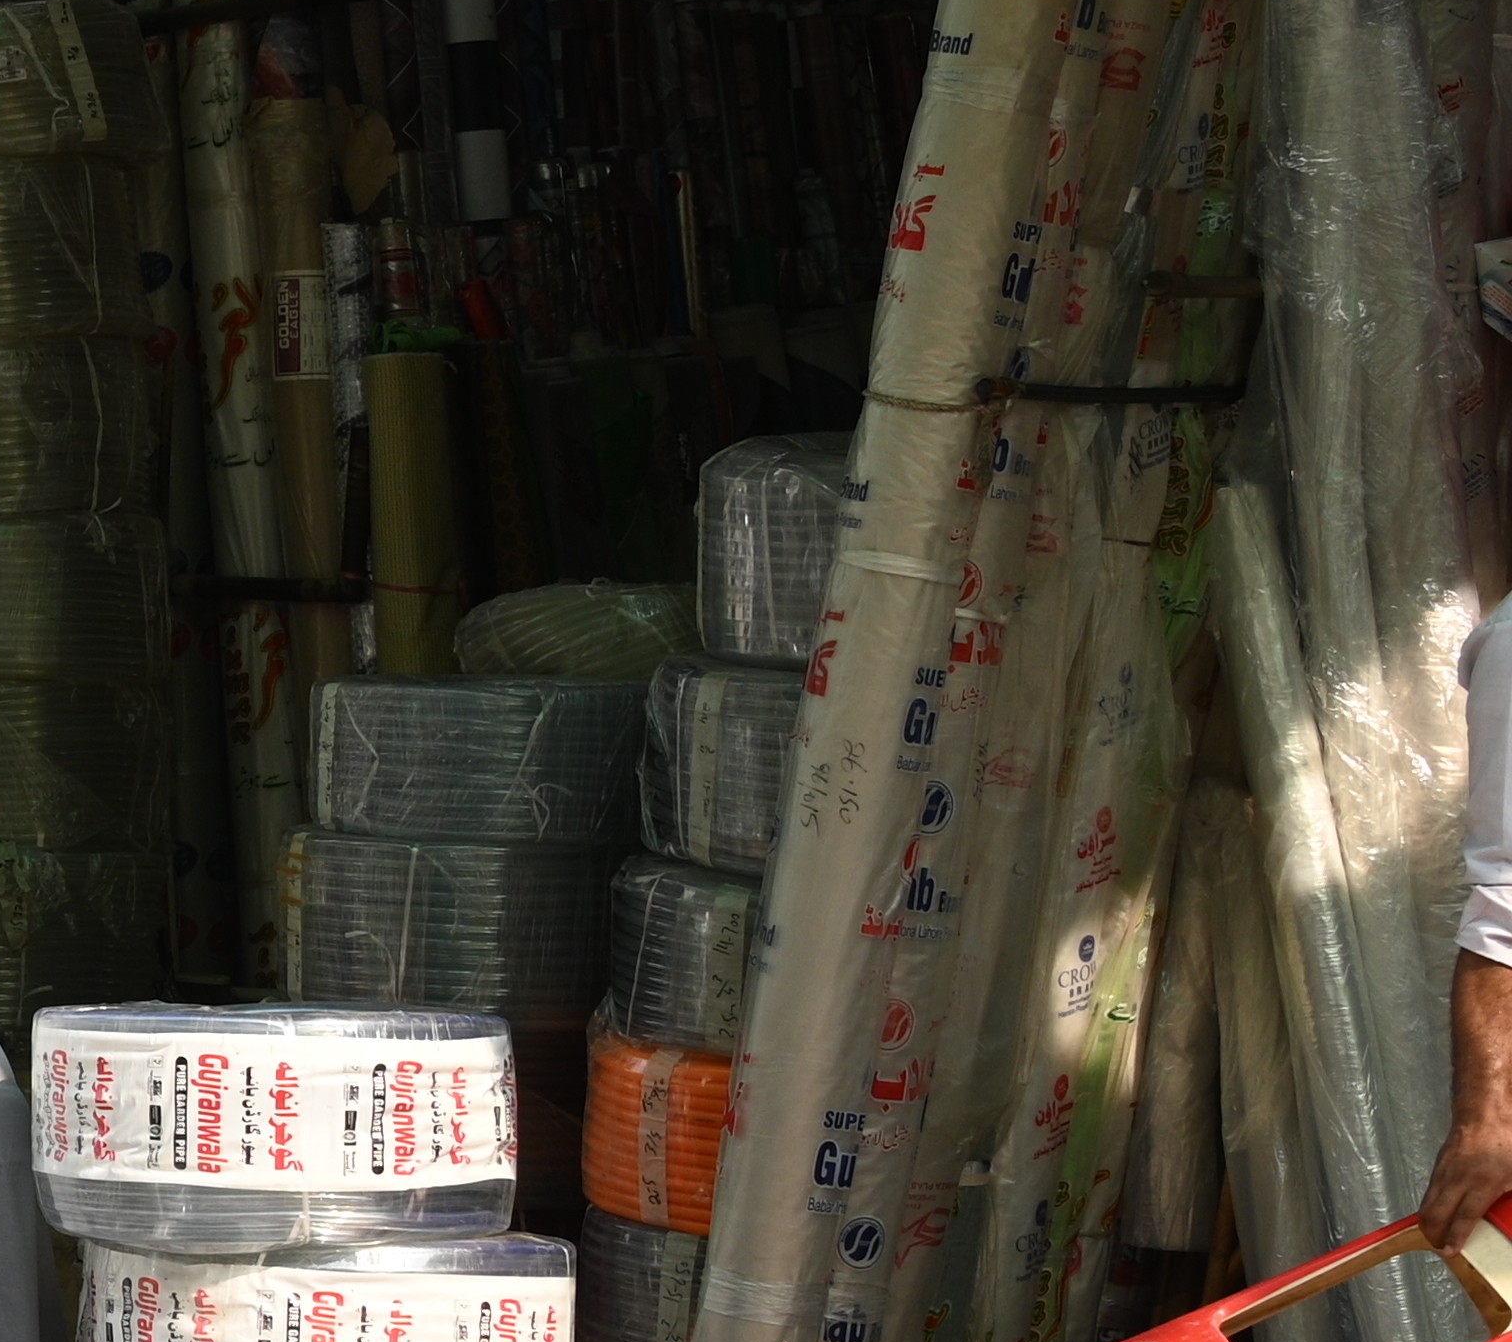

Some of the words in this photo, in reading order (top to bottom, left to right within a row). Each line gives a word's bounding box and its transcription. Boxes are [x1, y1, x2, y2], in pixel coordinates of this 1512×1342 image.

[278, 279, 290, 350] GOLDEN
[289, 289, 300, 340] EAGLE
[174, 1063, 187, 1092] PURE
[91, 1055, 117, 1162] گوجرانوالہ
[174, 1093, 187, 1136] GARDEN
[196, 1052, 230, 1174] Gujranwala
[270, 1061, 304, 1171] گوجرانوالہ
[392, 1060, 423, 1176] Gujranwala
[449, 1066, 472, 1165] گوجرانوالہ
[823, 1110, 866, 1131] SUPE
[174, 1138, 187, 1164] PIPE
[285, 1296, 300, 1328] PURE
